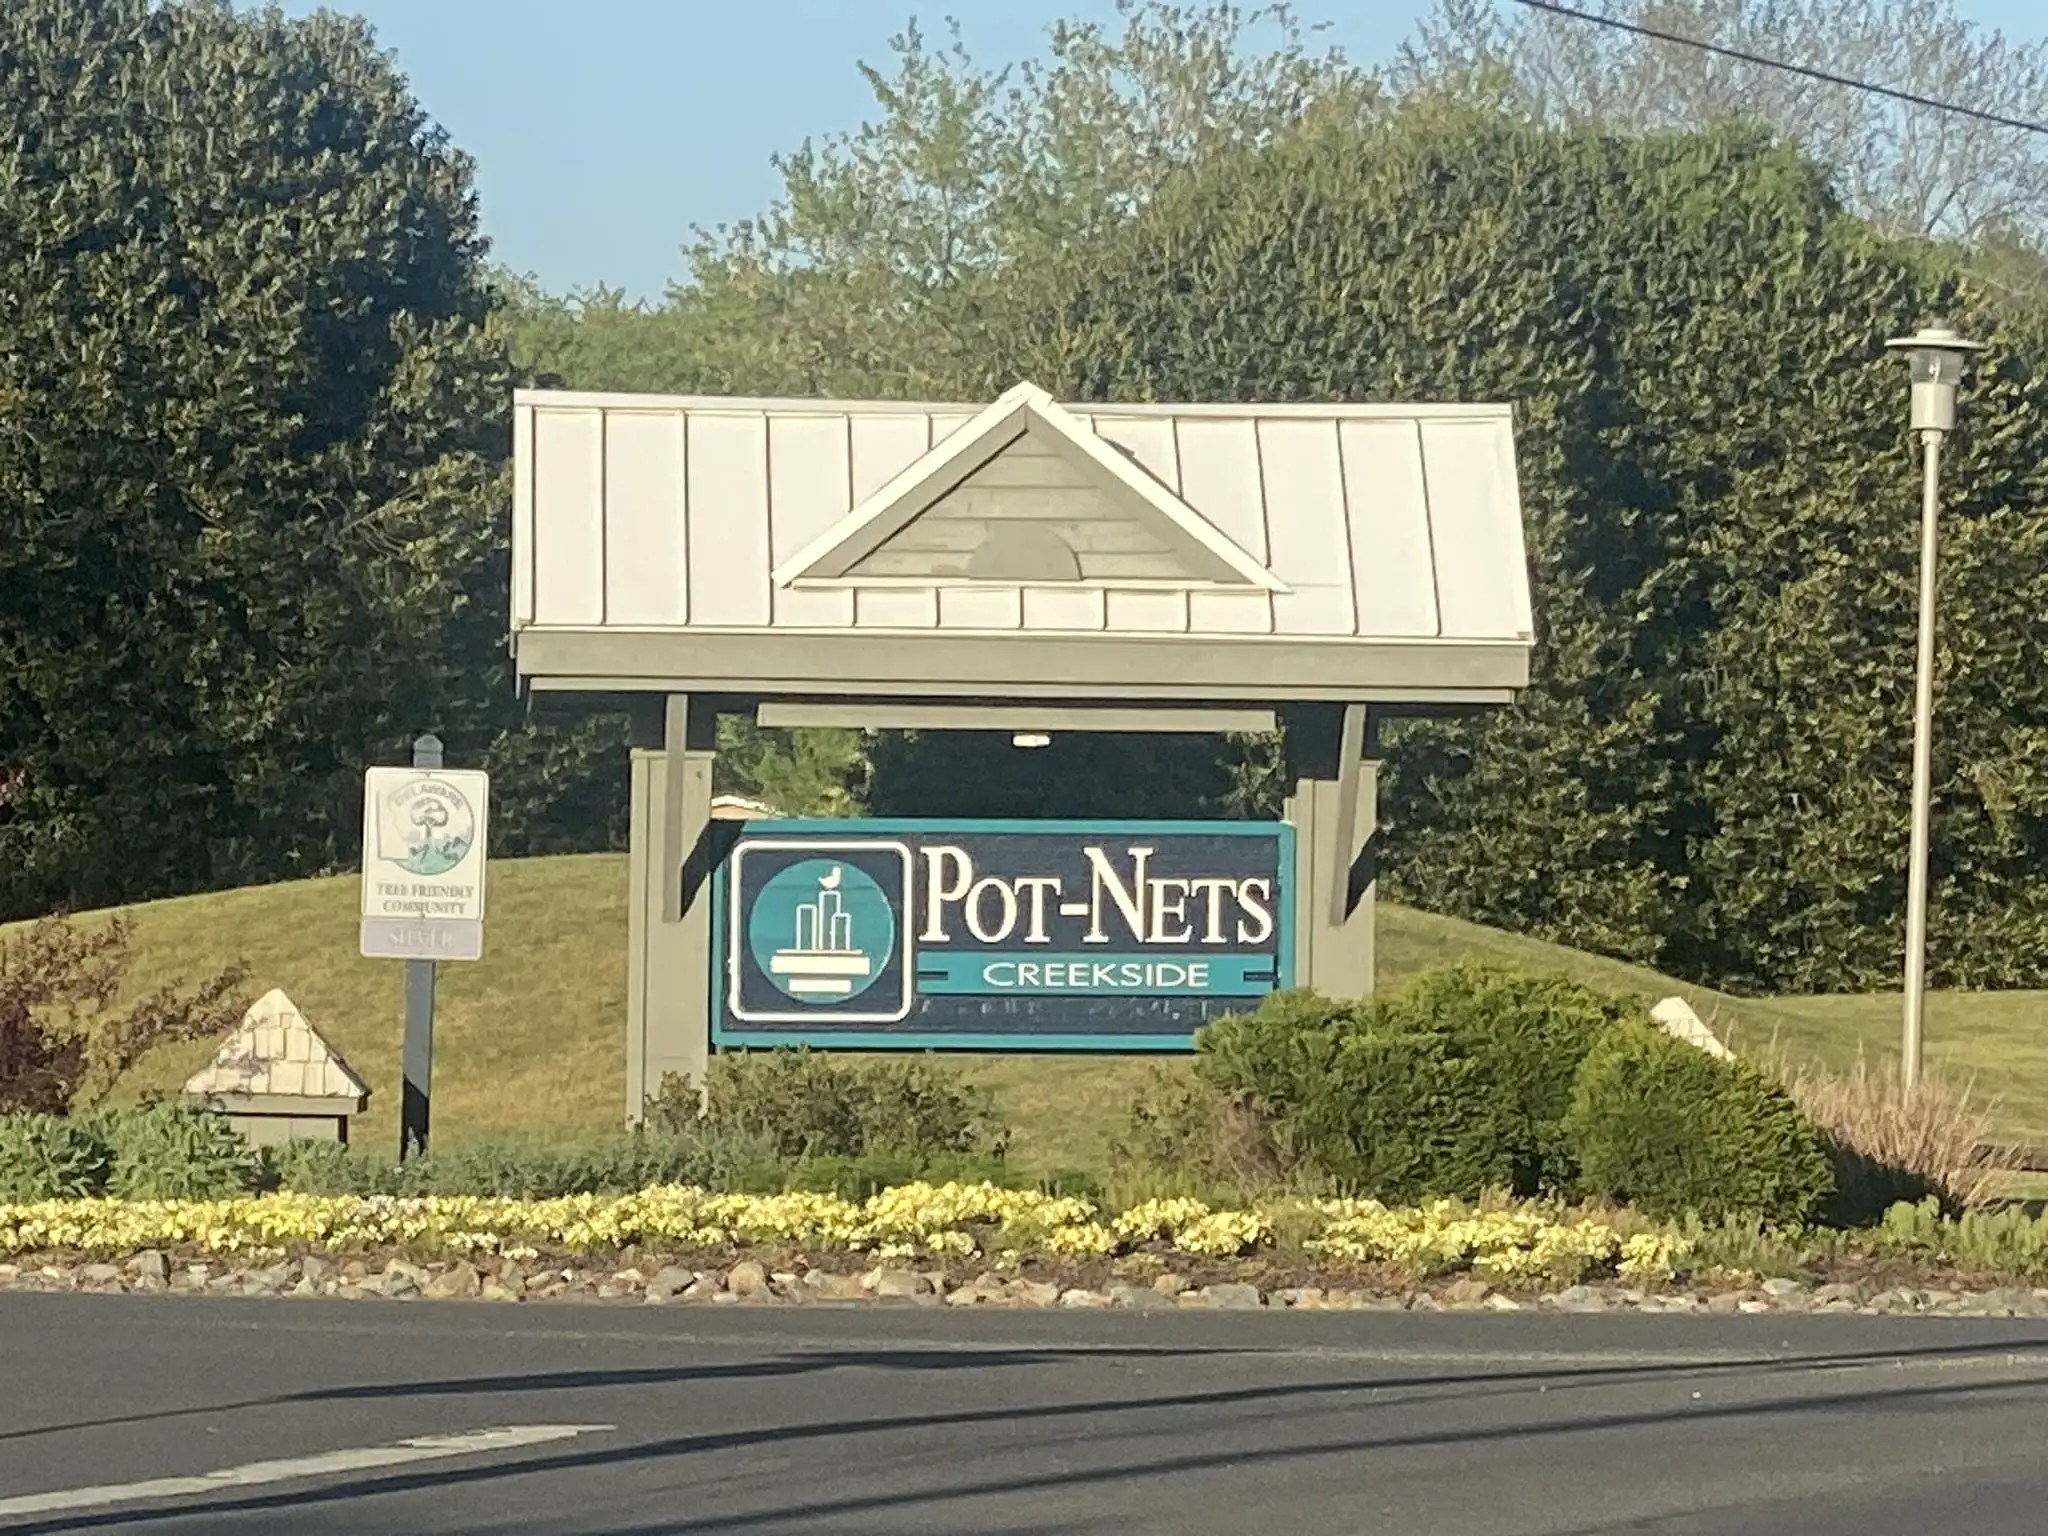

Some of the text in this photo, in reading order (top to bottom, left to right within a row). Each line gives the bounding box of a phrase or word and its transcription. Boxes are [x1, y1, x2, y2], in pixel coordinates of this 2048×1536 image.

[377, 883, 475, 898] TREE FRIENDLY
[382, 901, 468, 915] COMMUNITY
[982, 961, 1210, 988] CREEKSIDE
